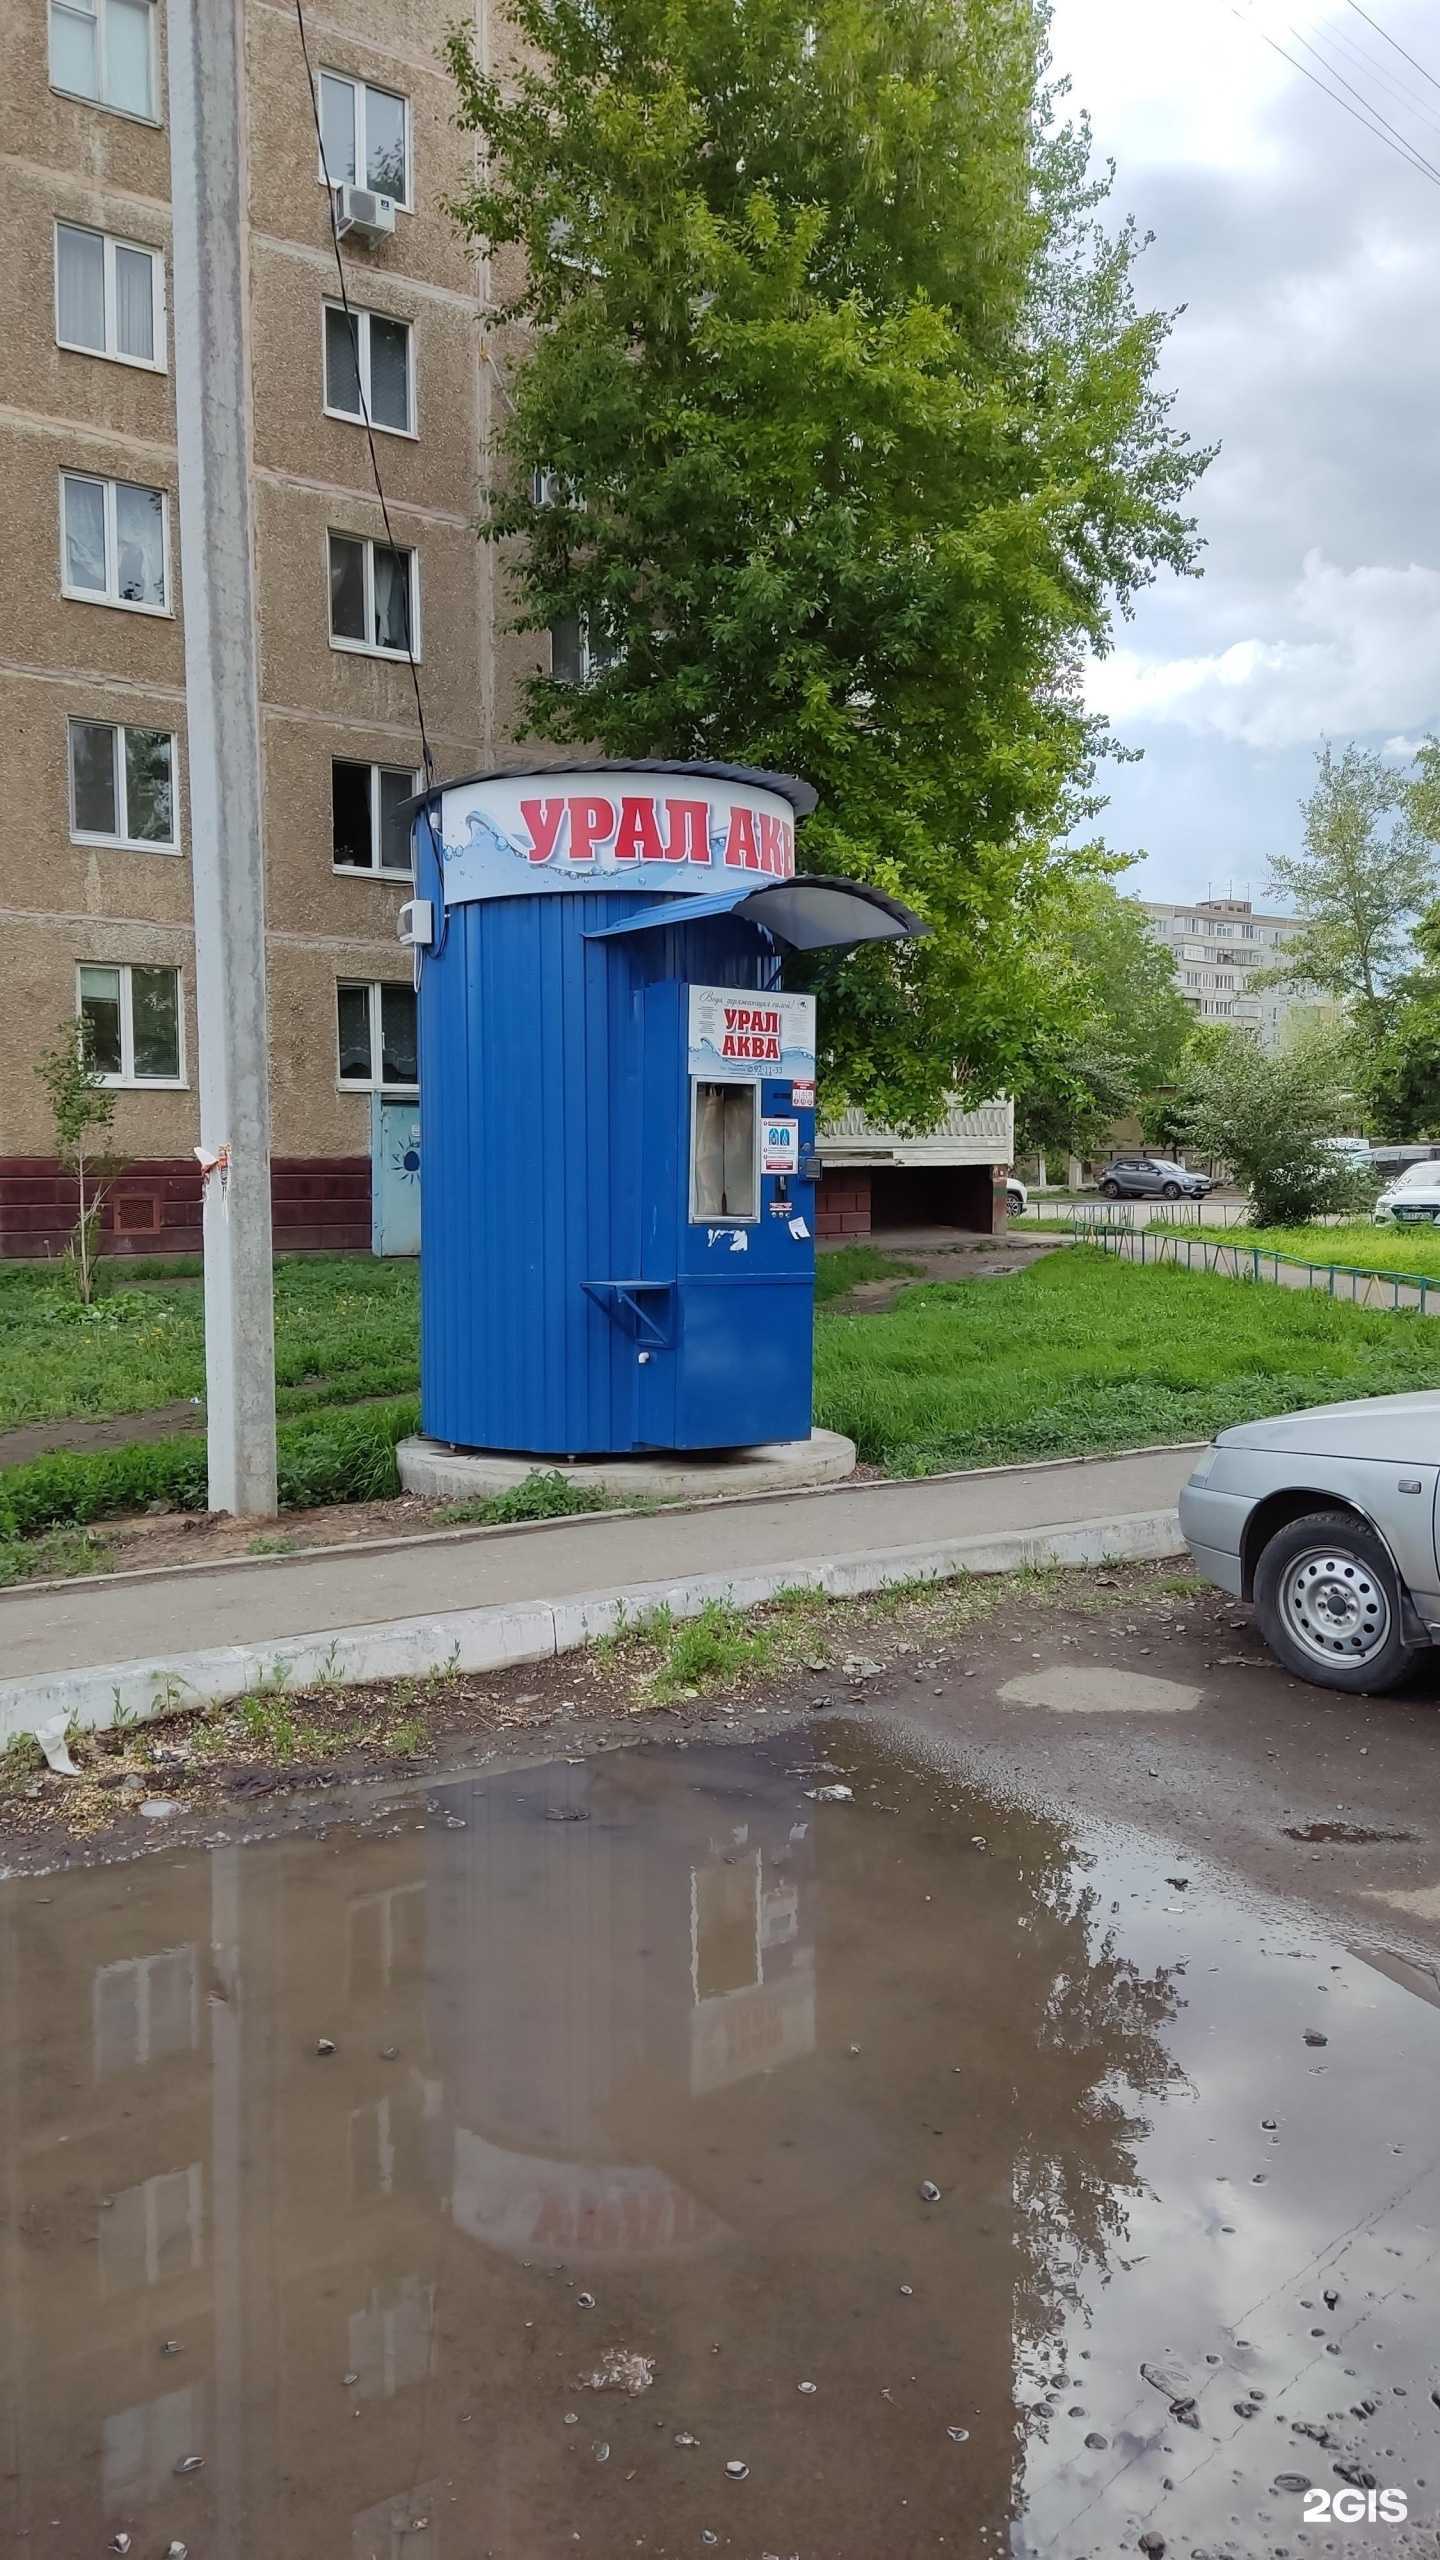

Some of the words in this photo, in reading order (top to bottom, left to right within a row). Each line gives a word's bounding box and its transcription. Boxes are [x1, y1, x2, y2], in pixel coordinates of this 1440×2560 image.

[520, 796, 711, 864] УРАЛ
[723, 1008, 779, 1033] УРАЛ
[721, 1034, 780, 1058] АКВА
